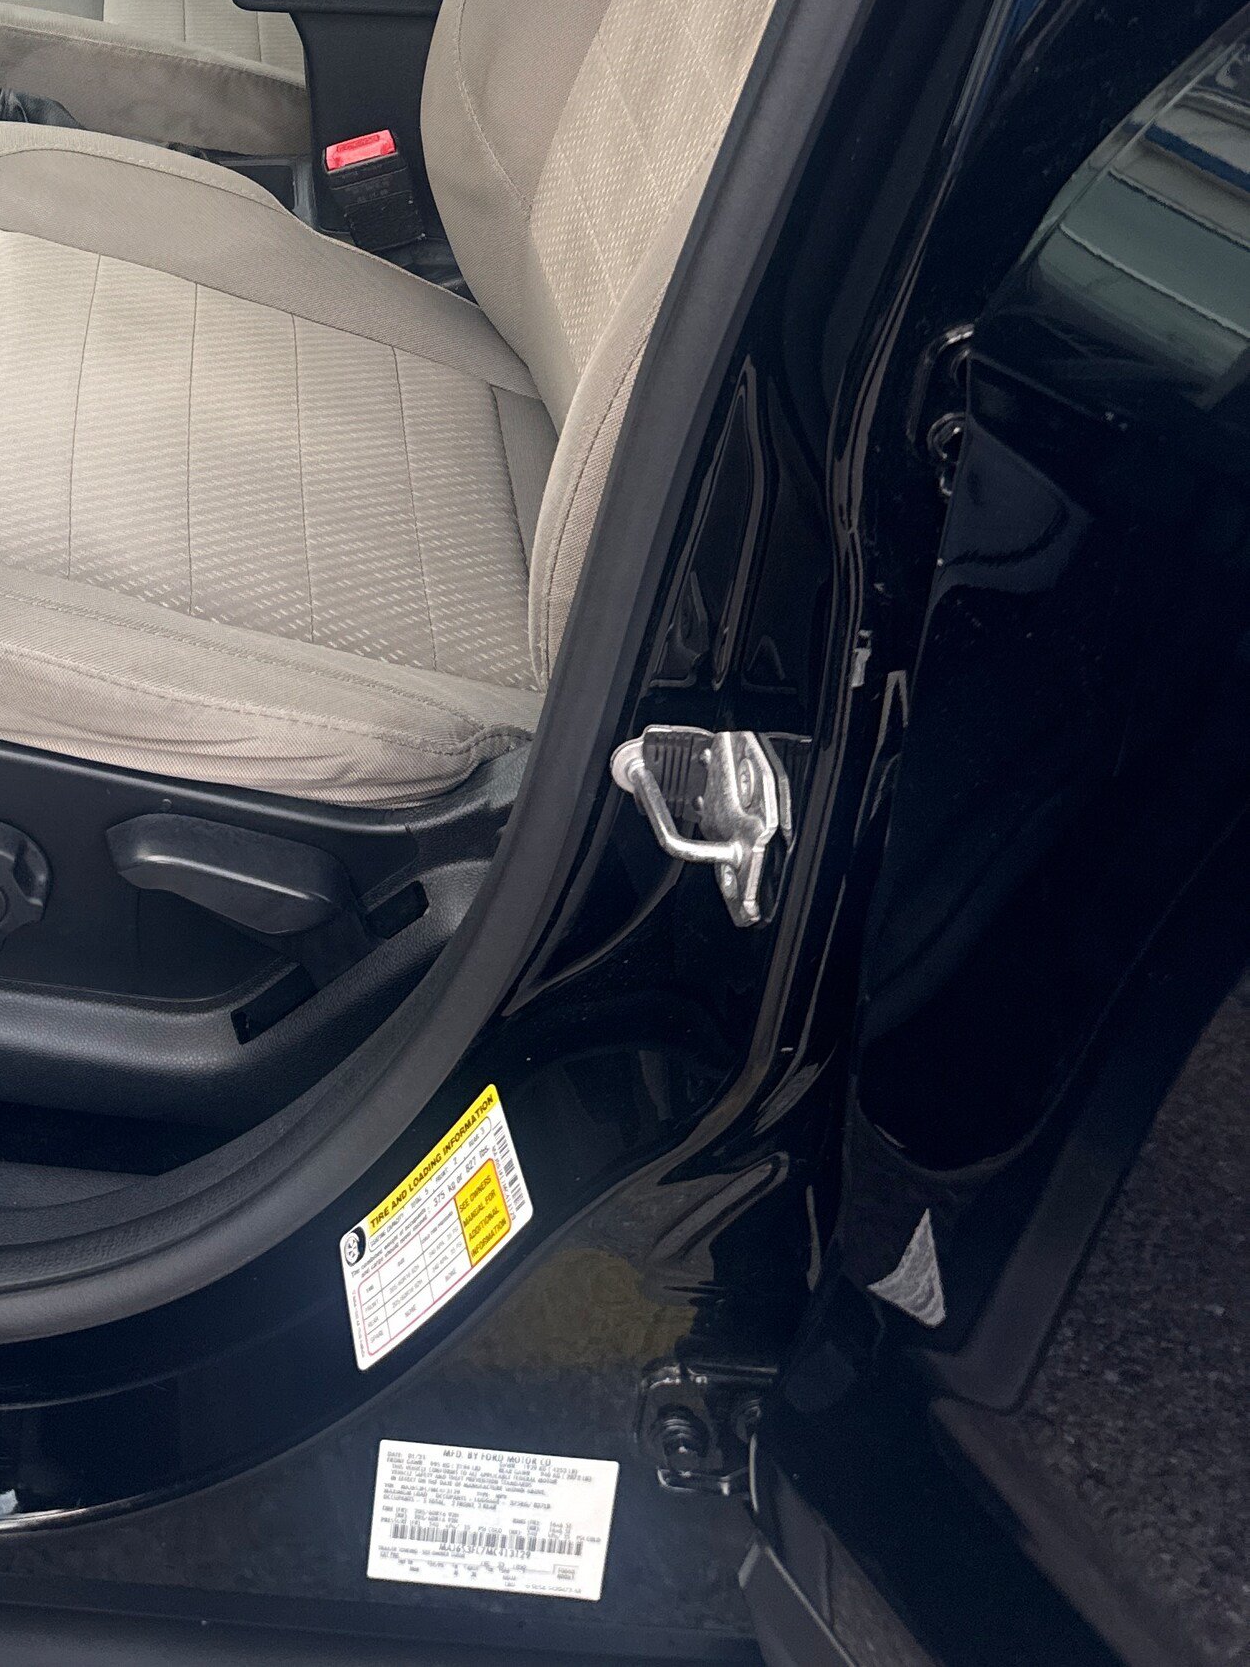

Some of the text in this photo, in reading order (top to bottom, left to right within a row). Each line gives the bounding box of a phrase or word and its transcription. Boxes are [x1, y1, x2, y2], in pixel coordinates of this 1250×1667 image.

[370, 1093, 493, 1230] TIRE AND LOADING INFORMATION
[432, 1188, 445, 1207] 375
[447, 1178, 456, 1194] kg
[455, 1171, 463, 1184] or
[464, 1155, 477, 1174] 827
[458, 1173, 491, 1213] SEE OWNERS
[462, 1187, 496, 1228] MANUAL FOR
[468, 1204, 499, 1241] ADDITIONAL
[470, 1216, 507, 1258] INFORMATION
[480, 1453, 503, 1462] FORD
[506, 1455, 537, 1465] MOTOR
[539, 1458, 551, 1466] CO
